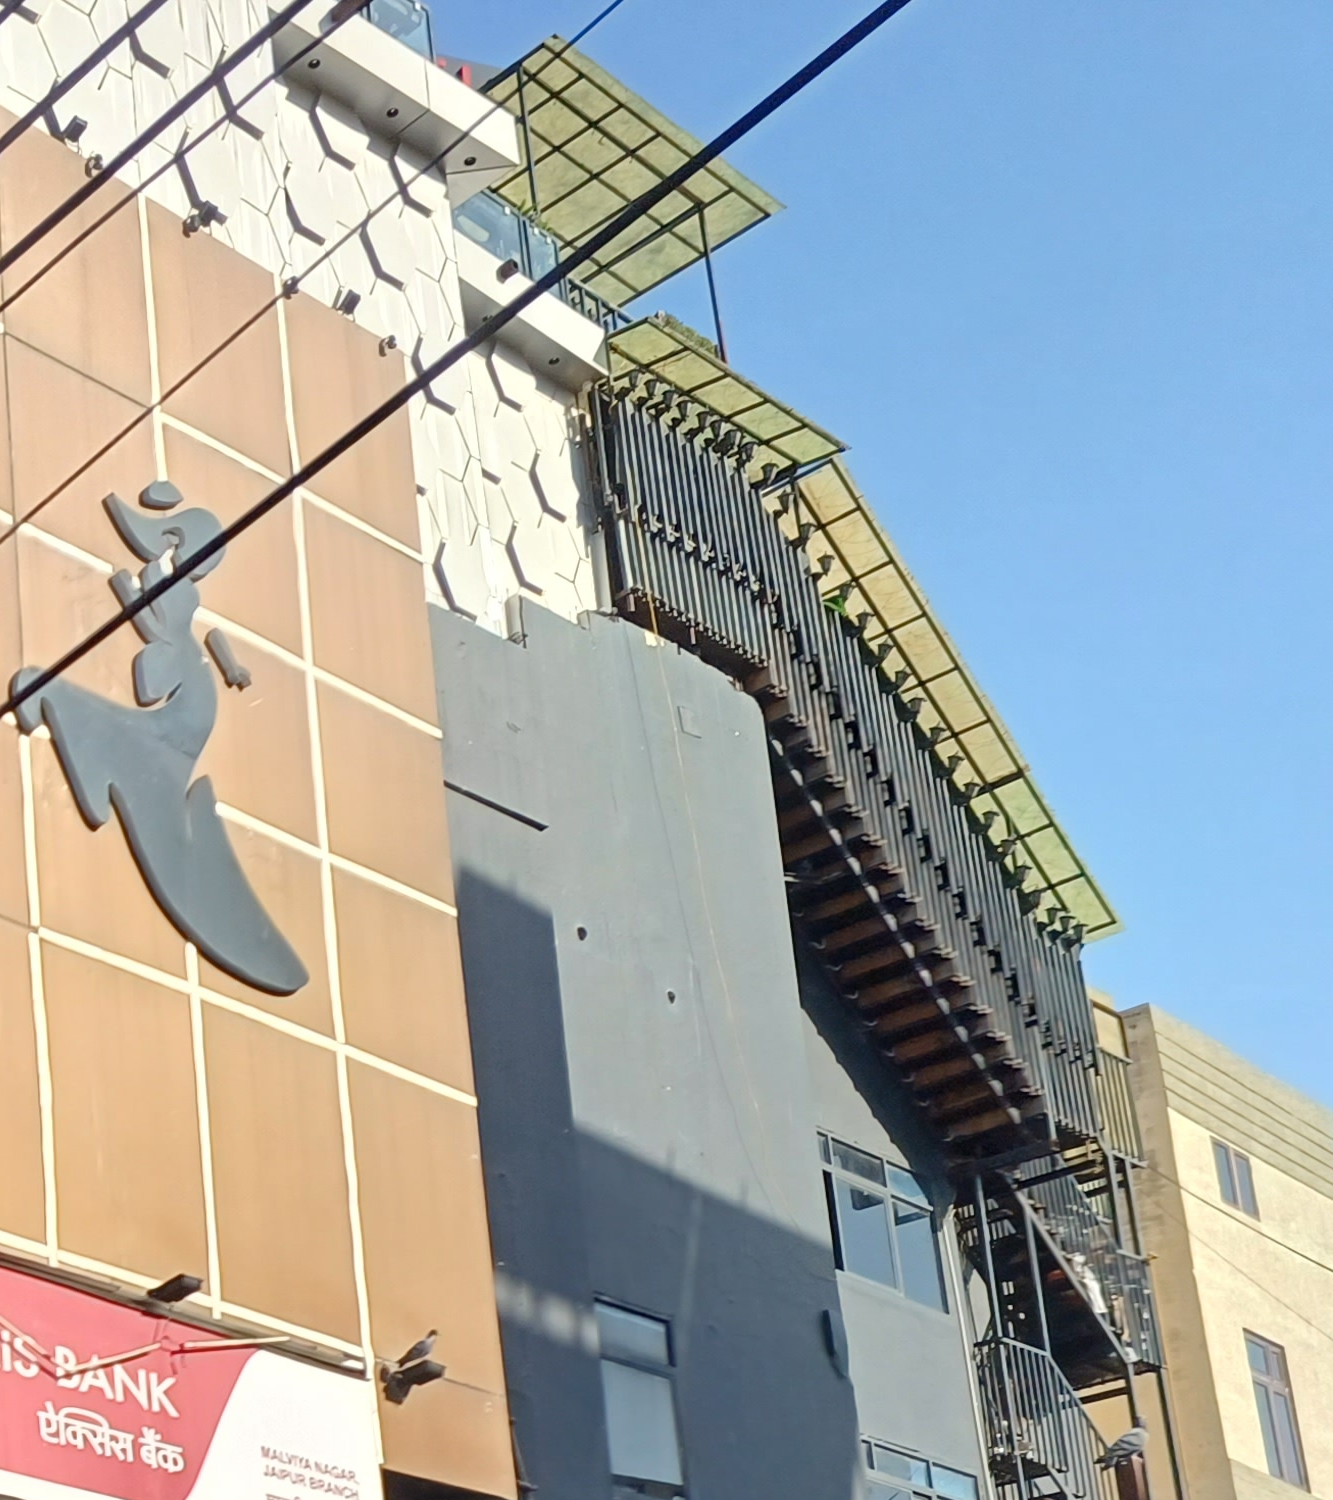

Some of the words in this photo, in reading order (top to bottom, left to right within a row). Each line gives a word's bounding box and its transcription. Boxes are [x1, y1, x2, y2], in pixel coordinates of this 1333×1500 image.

[54, 1345, 180, 1418] BANK
[37, 1401, 135, 1463] ऐक्सिस
[138, 1426, 185, 1473] बैंक
[261, 1446, 312, 1471] MALVIYA
[263, 1464, 307, 1487] JAIPUR
[309, 1477, 359, 1500] BRANCH
